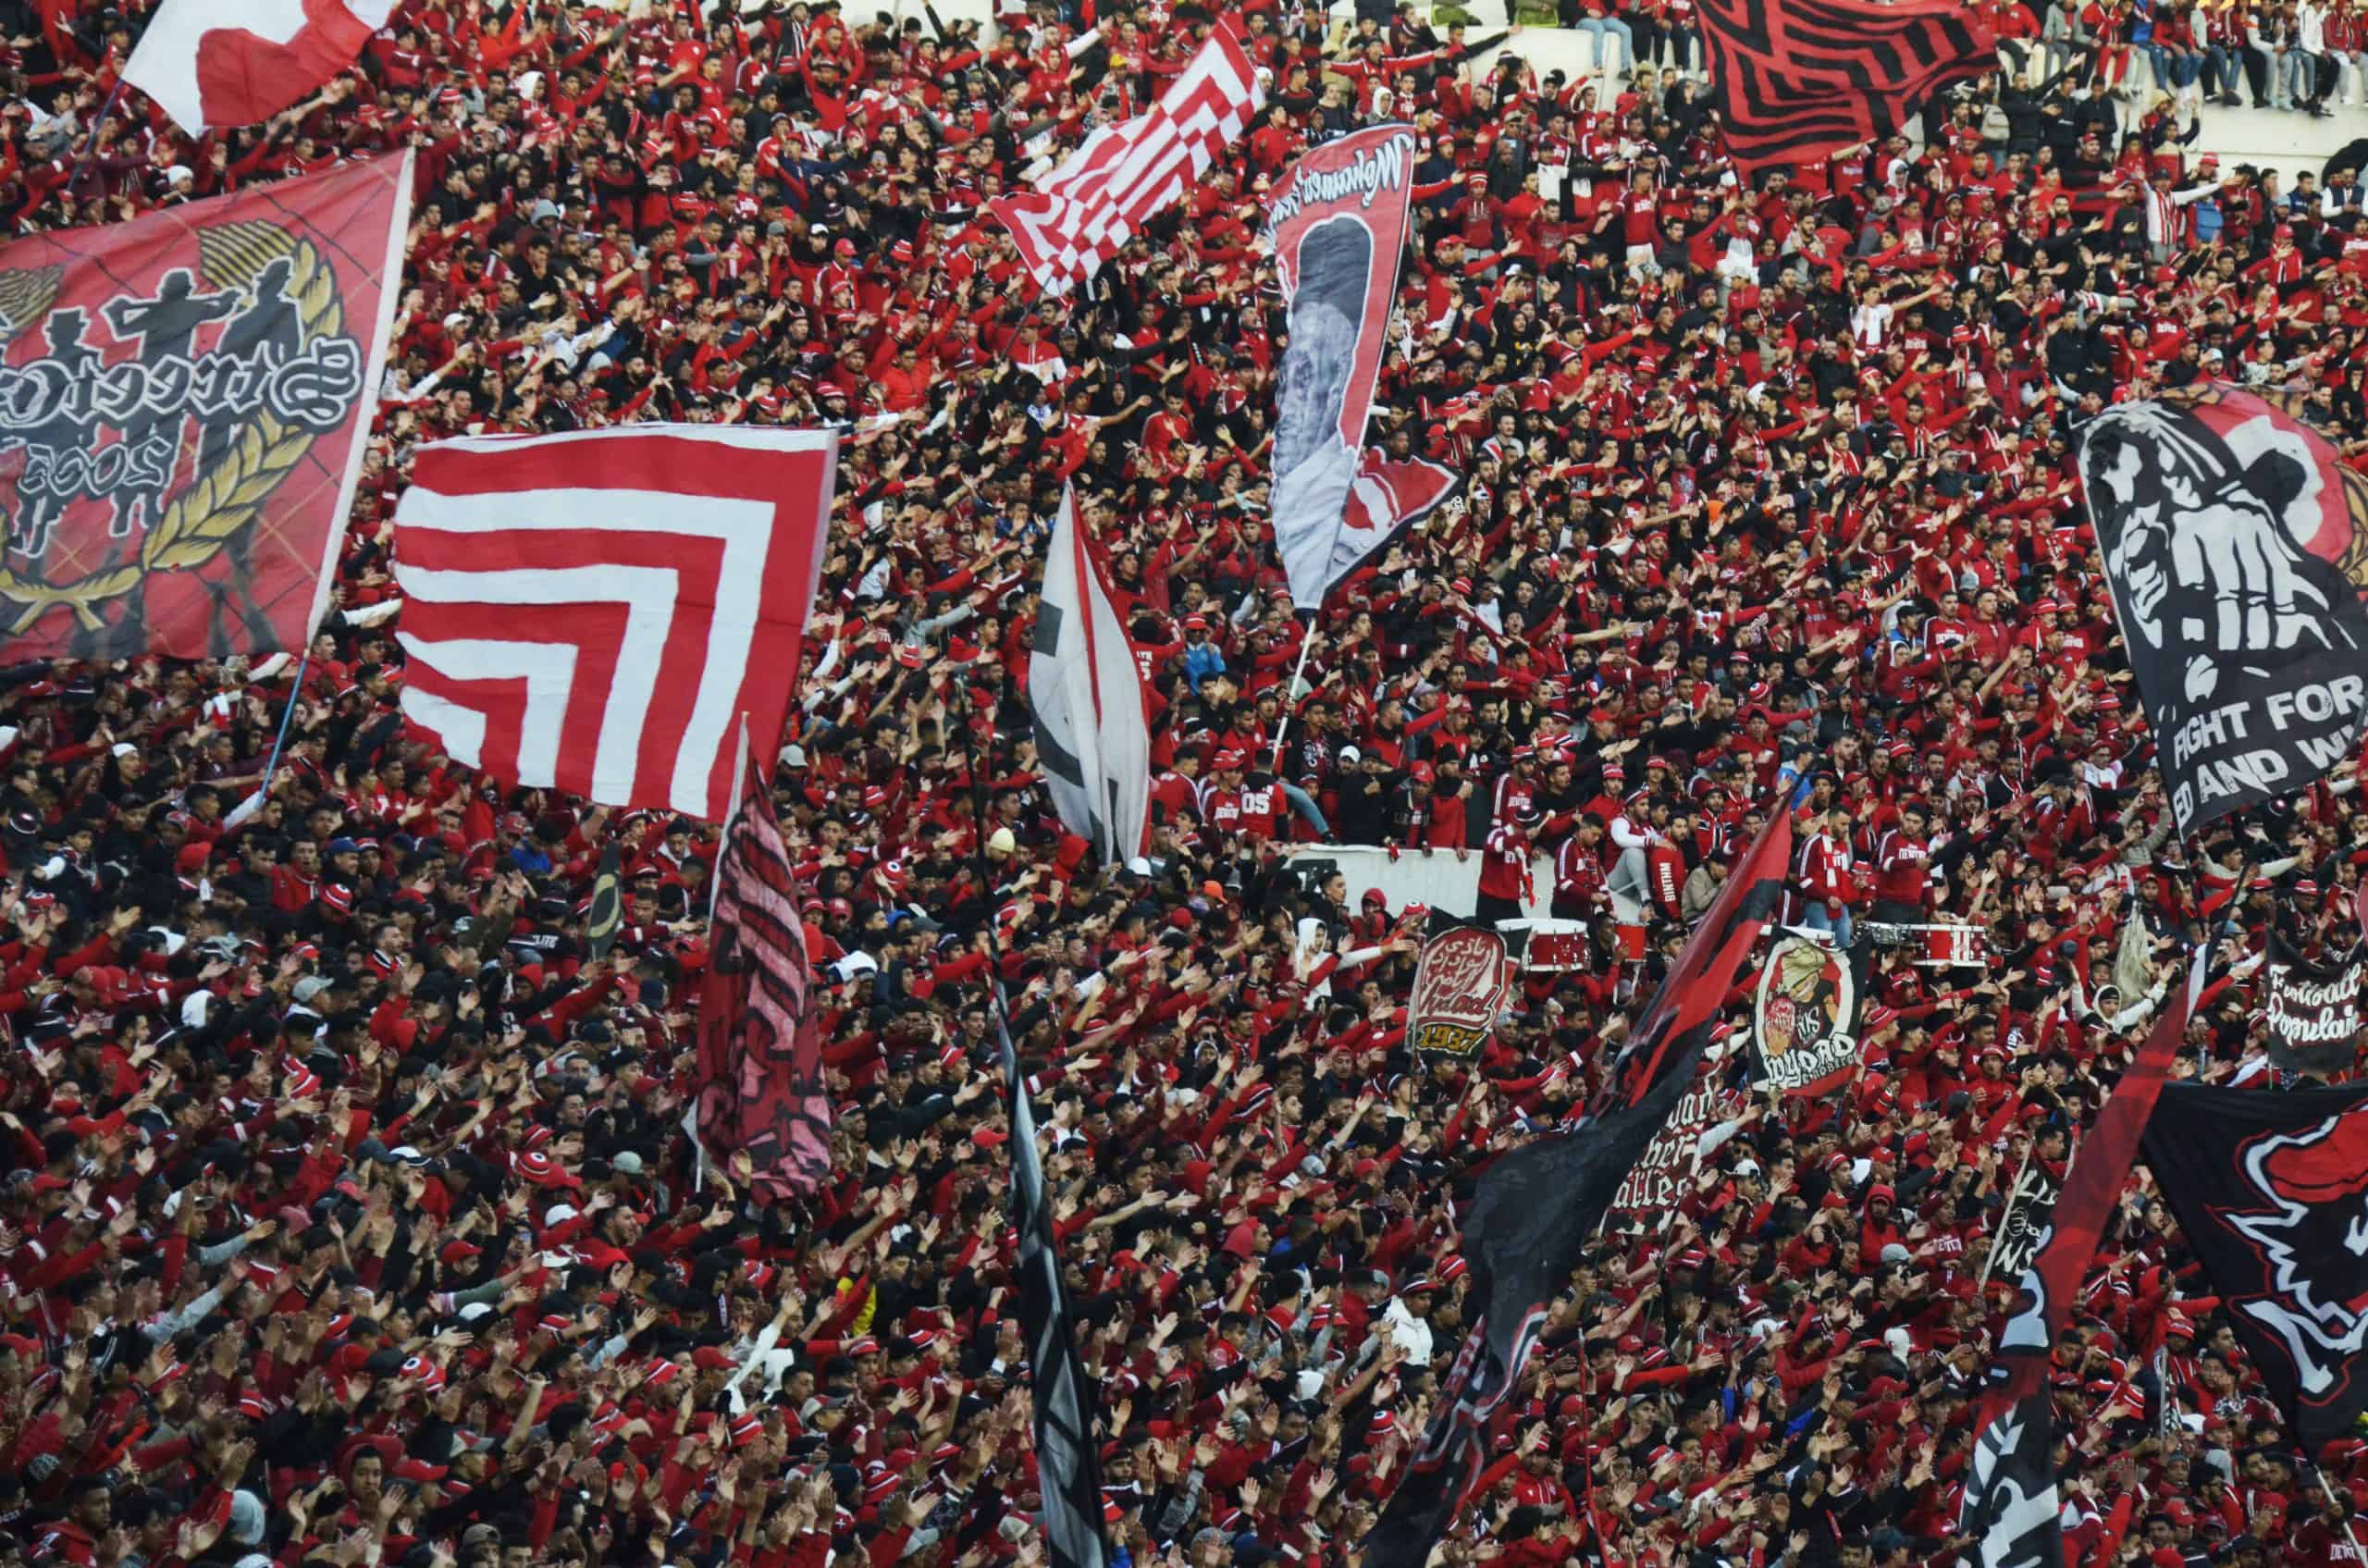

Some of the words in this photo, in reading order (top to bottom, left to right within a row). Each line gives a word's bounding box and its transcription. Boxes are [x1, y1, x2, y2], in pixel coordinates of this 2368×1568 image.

[2174, 701, 2251, 770] FIGHT
[2266, 674, 2365, 731] FOR
[2197, 748, 2289, 804] AND
[1241, 793, 1271, 815] 05
[1419, 1026, 1486, 1052] 1937
